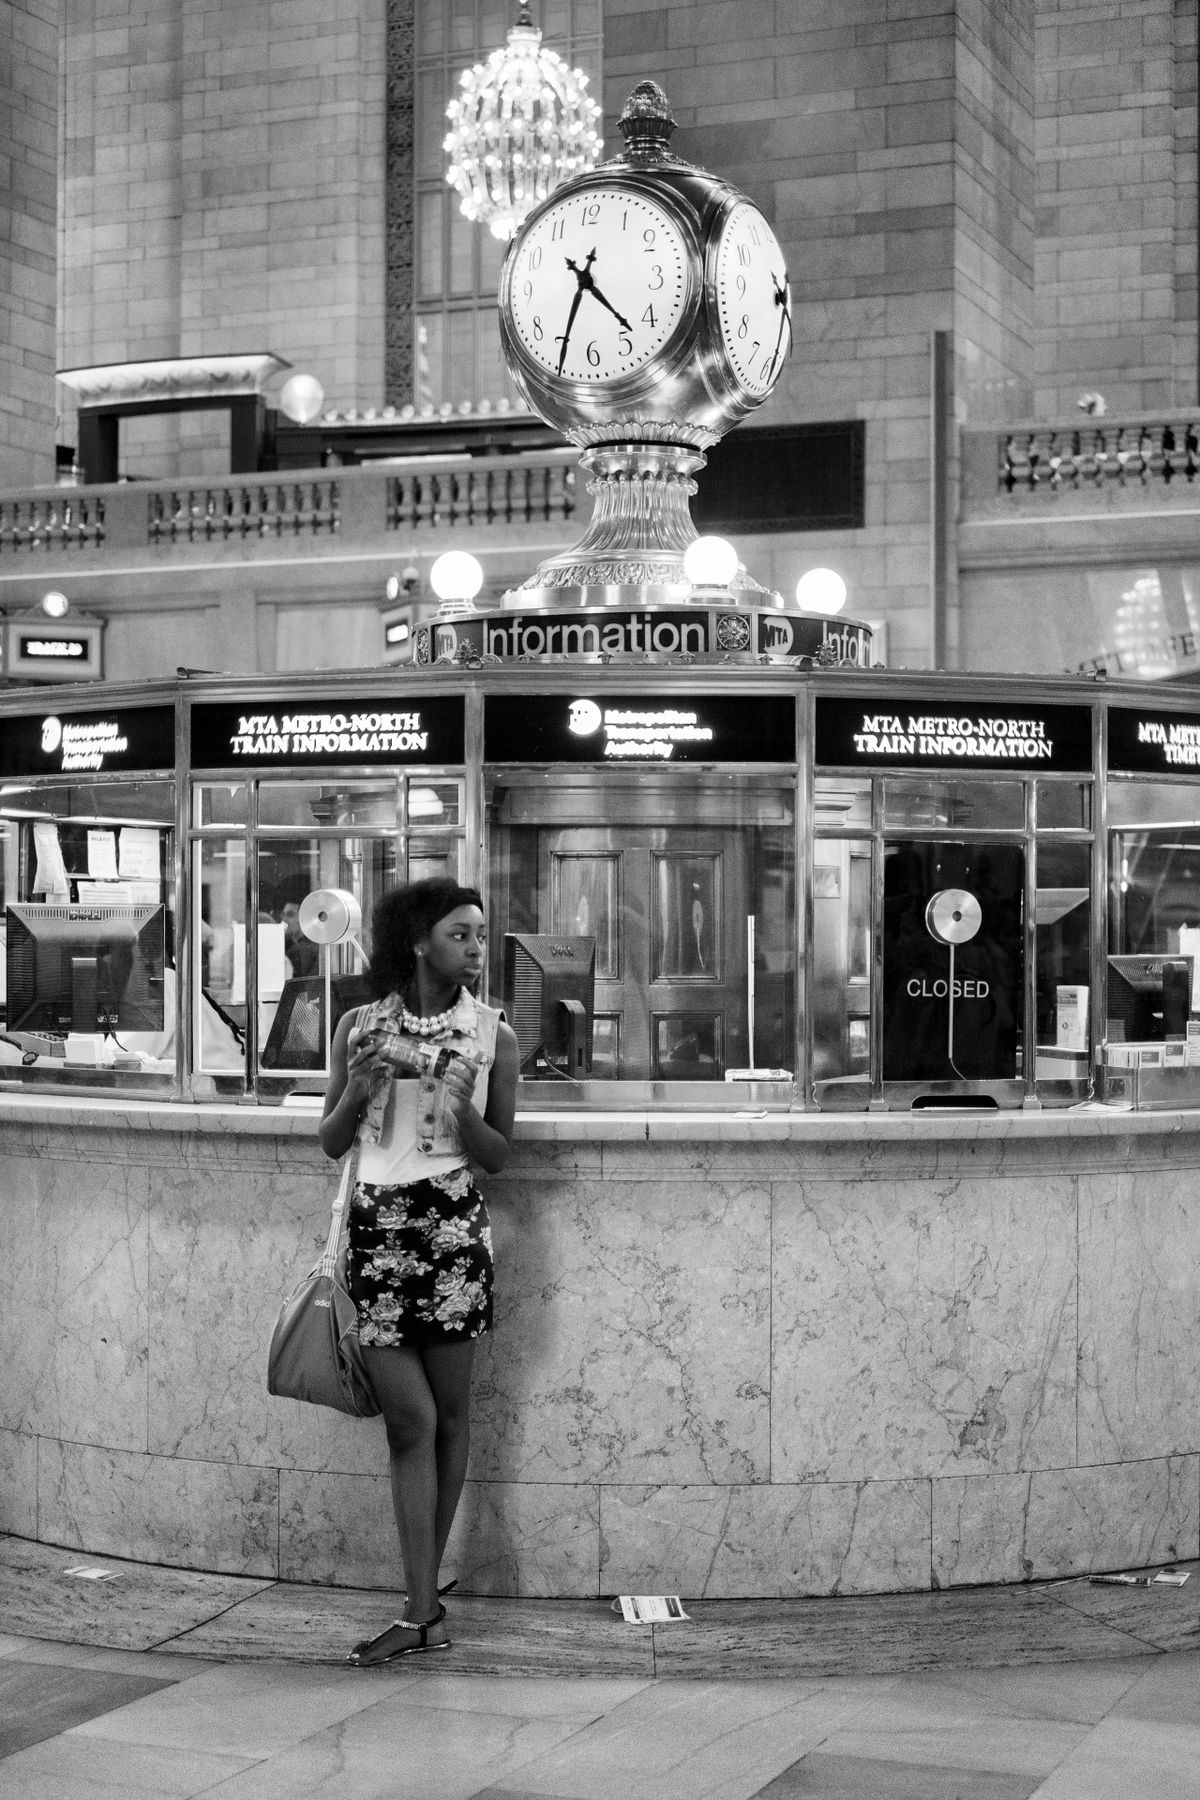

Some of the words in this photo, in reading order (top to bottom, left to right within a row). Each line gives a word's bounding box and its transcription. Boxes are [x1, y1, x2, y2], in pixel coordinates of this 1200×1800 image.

[581, 203, 601, 226] 12
[551, 218, 565, 241] 11
[643, 228, 656, 253] 2
[648, 264, 664, 290] 3
[641, 302, 658, 328] 4
[737, 314, 749, 339] 8
[533, 315, 544, 341] 8
[586, 340, 601, 367] 6
[618, 330, 633, 357] 5
[748, 340, 761, 365] 7
[482, 612, 706, 655] Information
[761, 622, 789, 649] MTA
[237, 715, 279, 735] MTA
[281, 713, 421, 734] METRO-NORTH
[862, 715, 904, 734] MTA
[907, 716, 1046, 738] METRO-NORTH
[1138, 721, 1168, 744] MTA
[229, 734, 290, 754] TRAIN
[292, 732, 429, 754] INFORMATION
[853, 734, 916, 754] TRAIN
[918, 735, 1054, 758] INFORMATION
[906, 978, 990, 999] CLOSED
